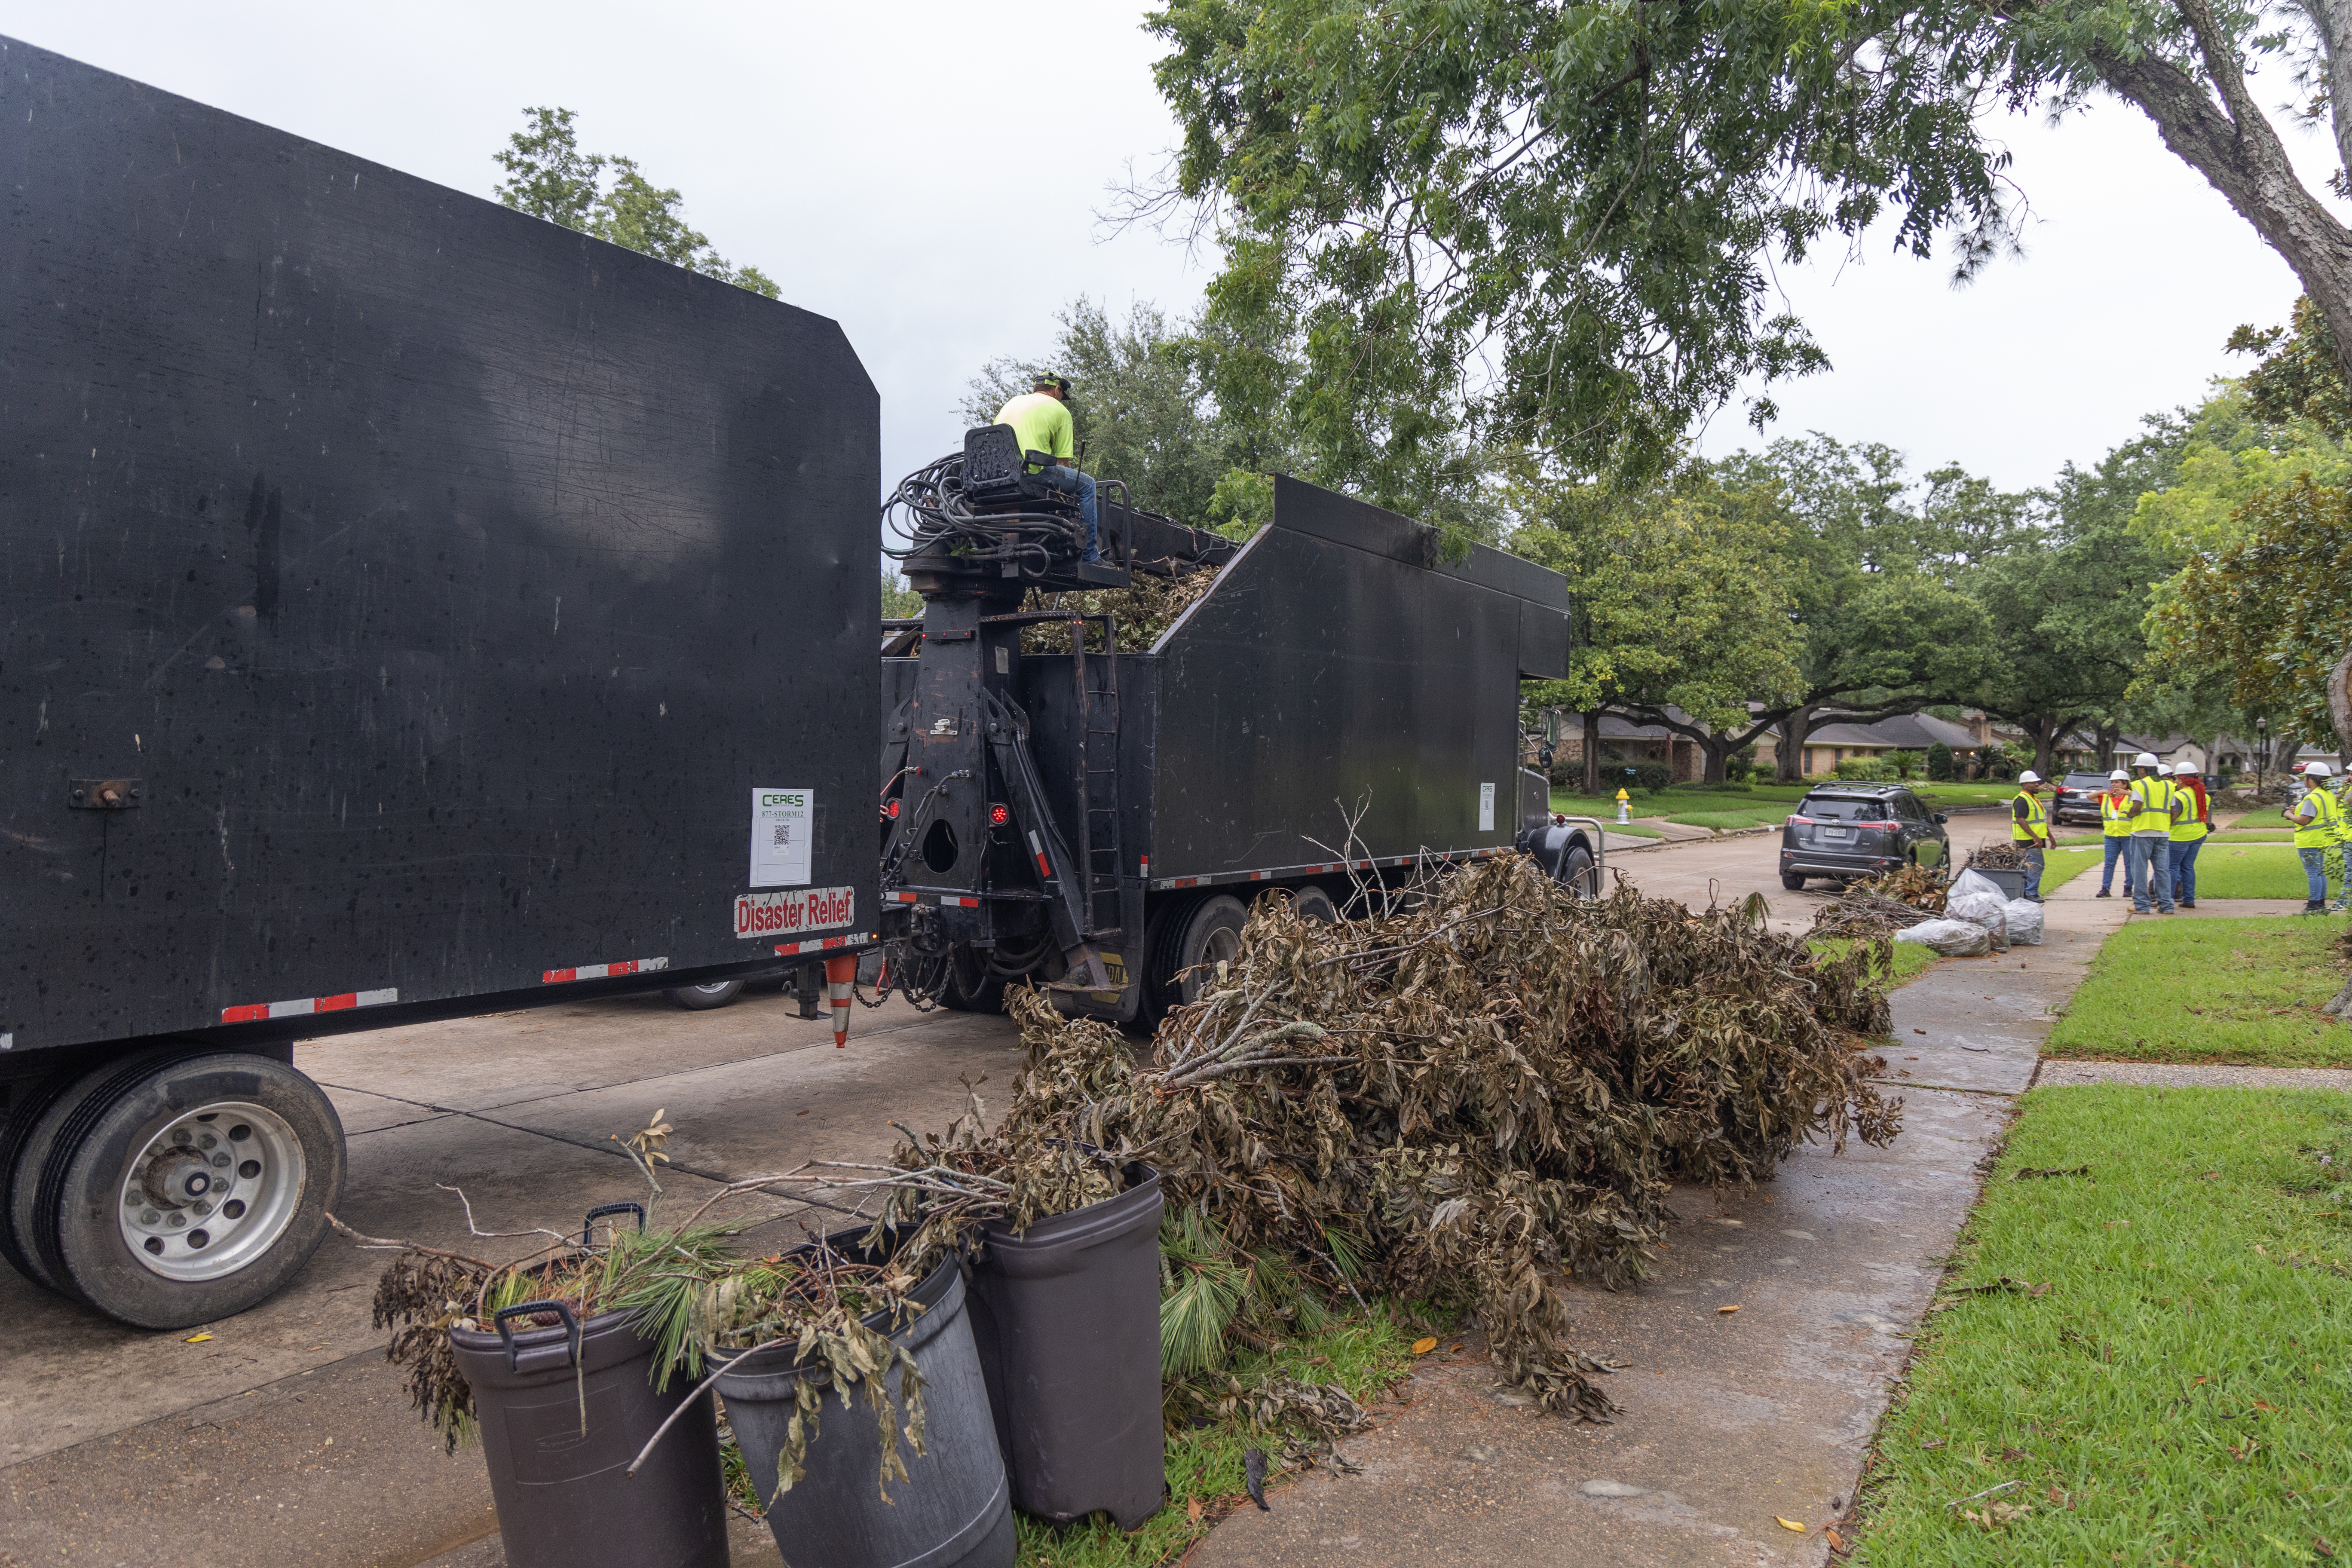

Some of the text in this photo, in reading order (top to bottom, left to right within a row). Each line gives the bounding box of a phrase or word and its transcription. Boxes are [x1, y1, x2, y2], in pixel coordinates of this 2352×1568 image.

[762, 794, 804, 807] CERES
[738, 890, 851, 933] Disaster Relief
